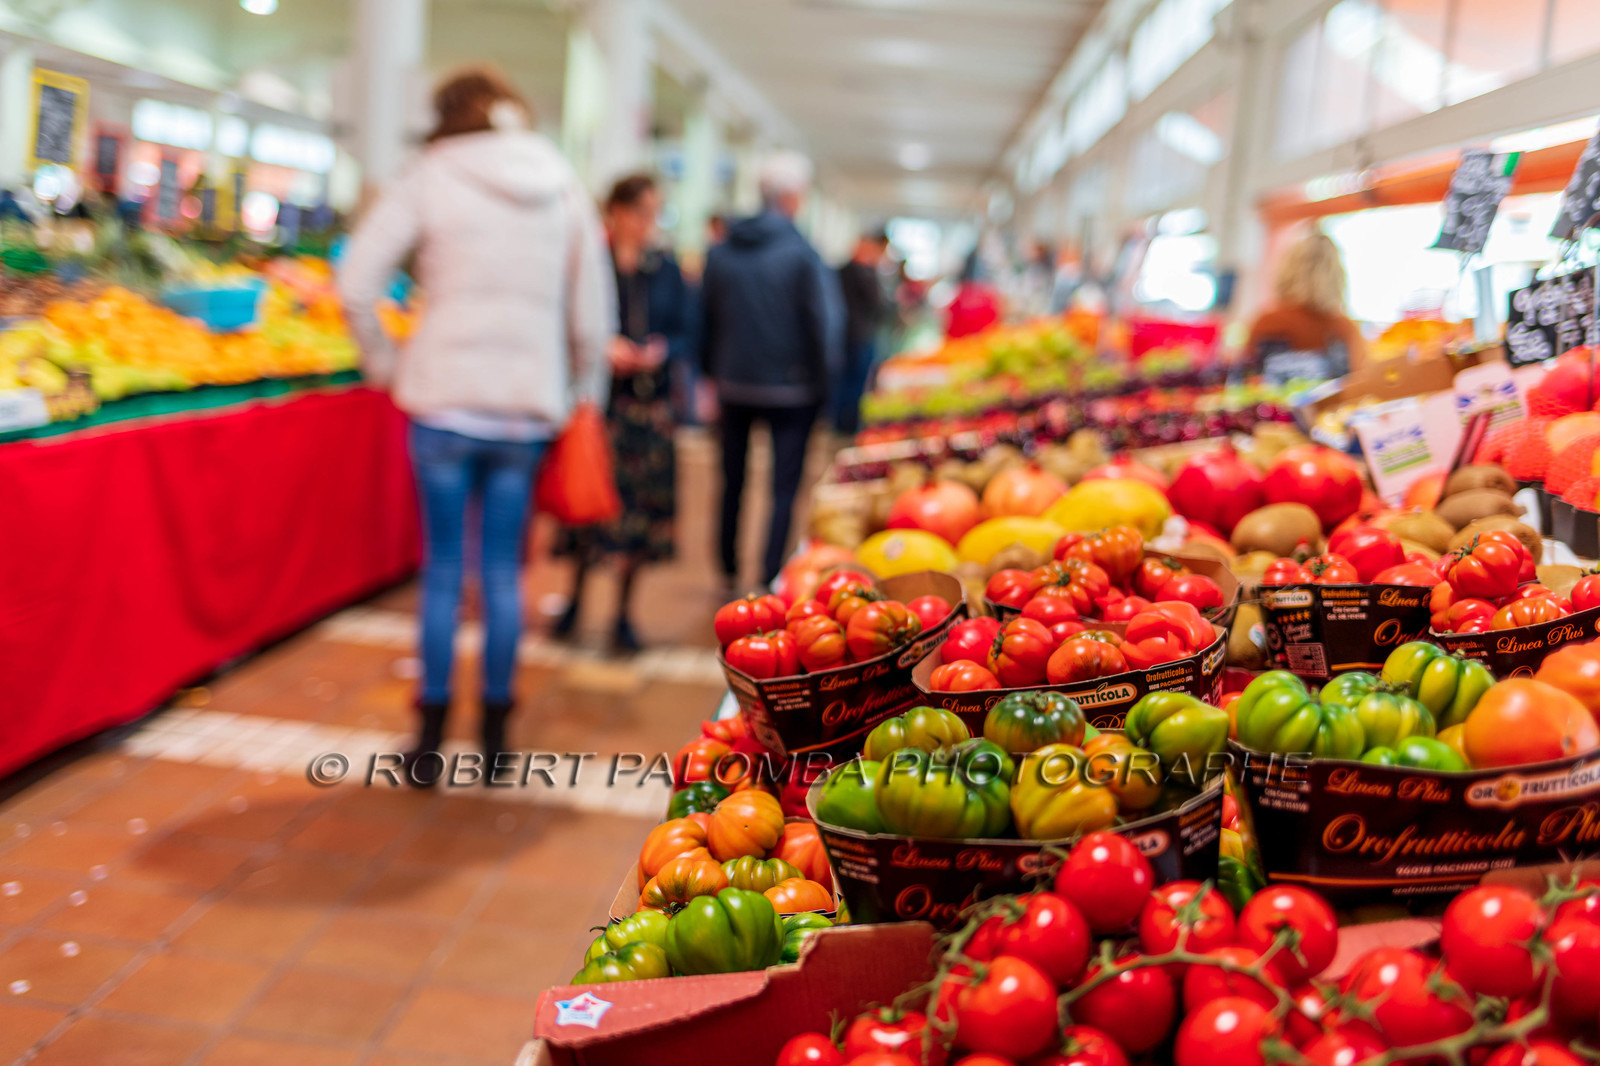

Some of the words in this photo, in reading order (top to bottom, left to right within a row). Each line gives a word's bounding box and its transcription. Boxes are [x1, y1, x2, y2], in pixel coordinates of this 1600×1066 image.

[1377, 588, 1420, 607] Linea
[1496, 636, 1544, 654] Linea
[1547, 623, 1584, 645] Plus
[818, 673, 860, 692] Linea
[1160, 677, 1186, 688] PACHINO
[942, 697, 981, 714] Linea
[1324, 768, 1392, 797] Linea
[1397, 776, 1450, 801] Plus
[1323, 813, 1527, 866] Orofrutticola
[890, 844, 951, 870] Linea
[955, 848, 1004, 871] Plus
[1433, 861, 1489, 873] PACHINO
